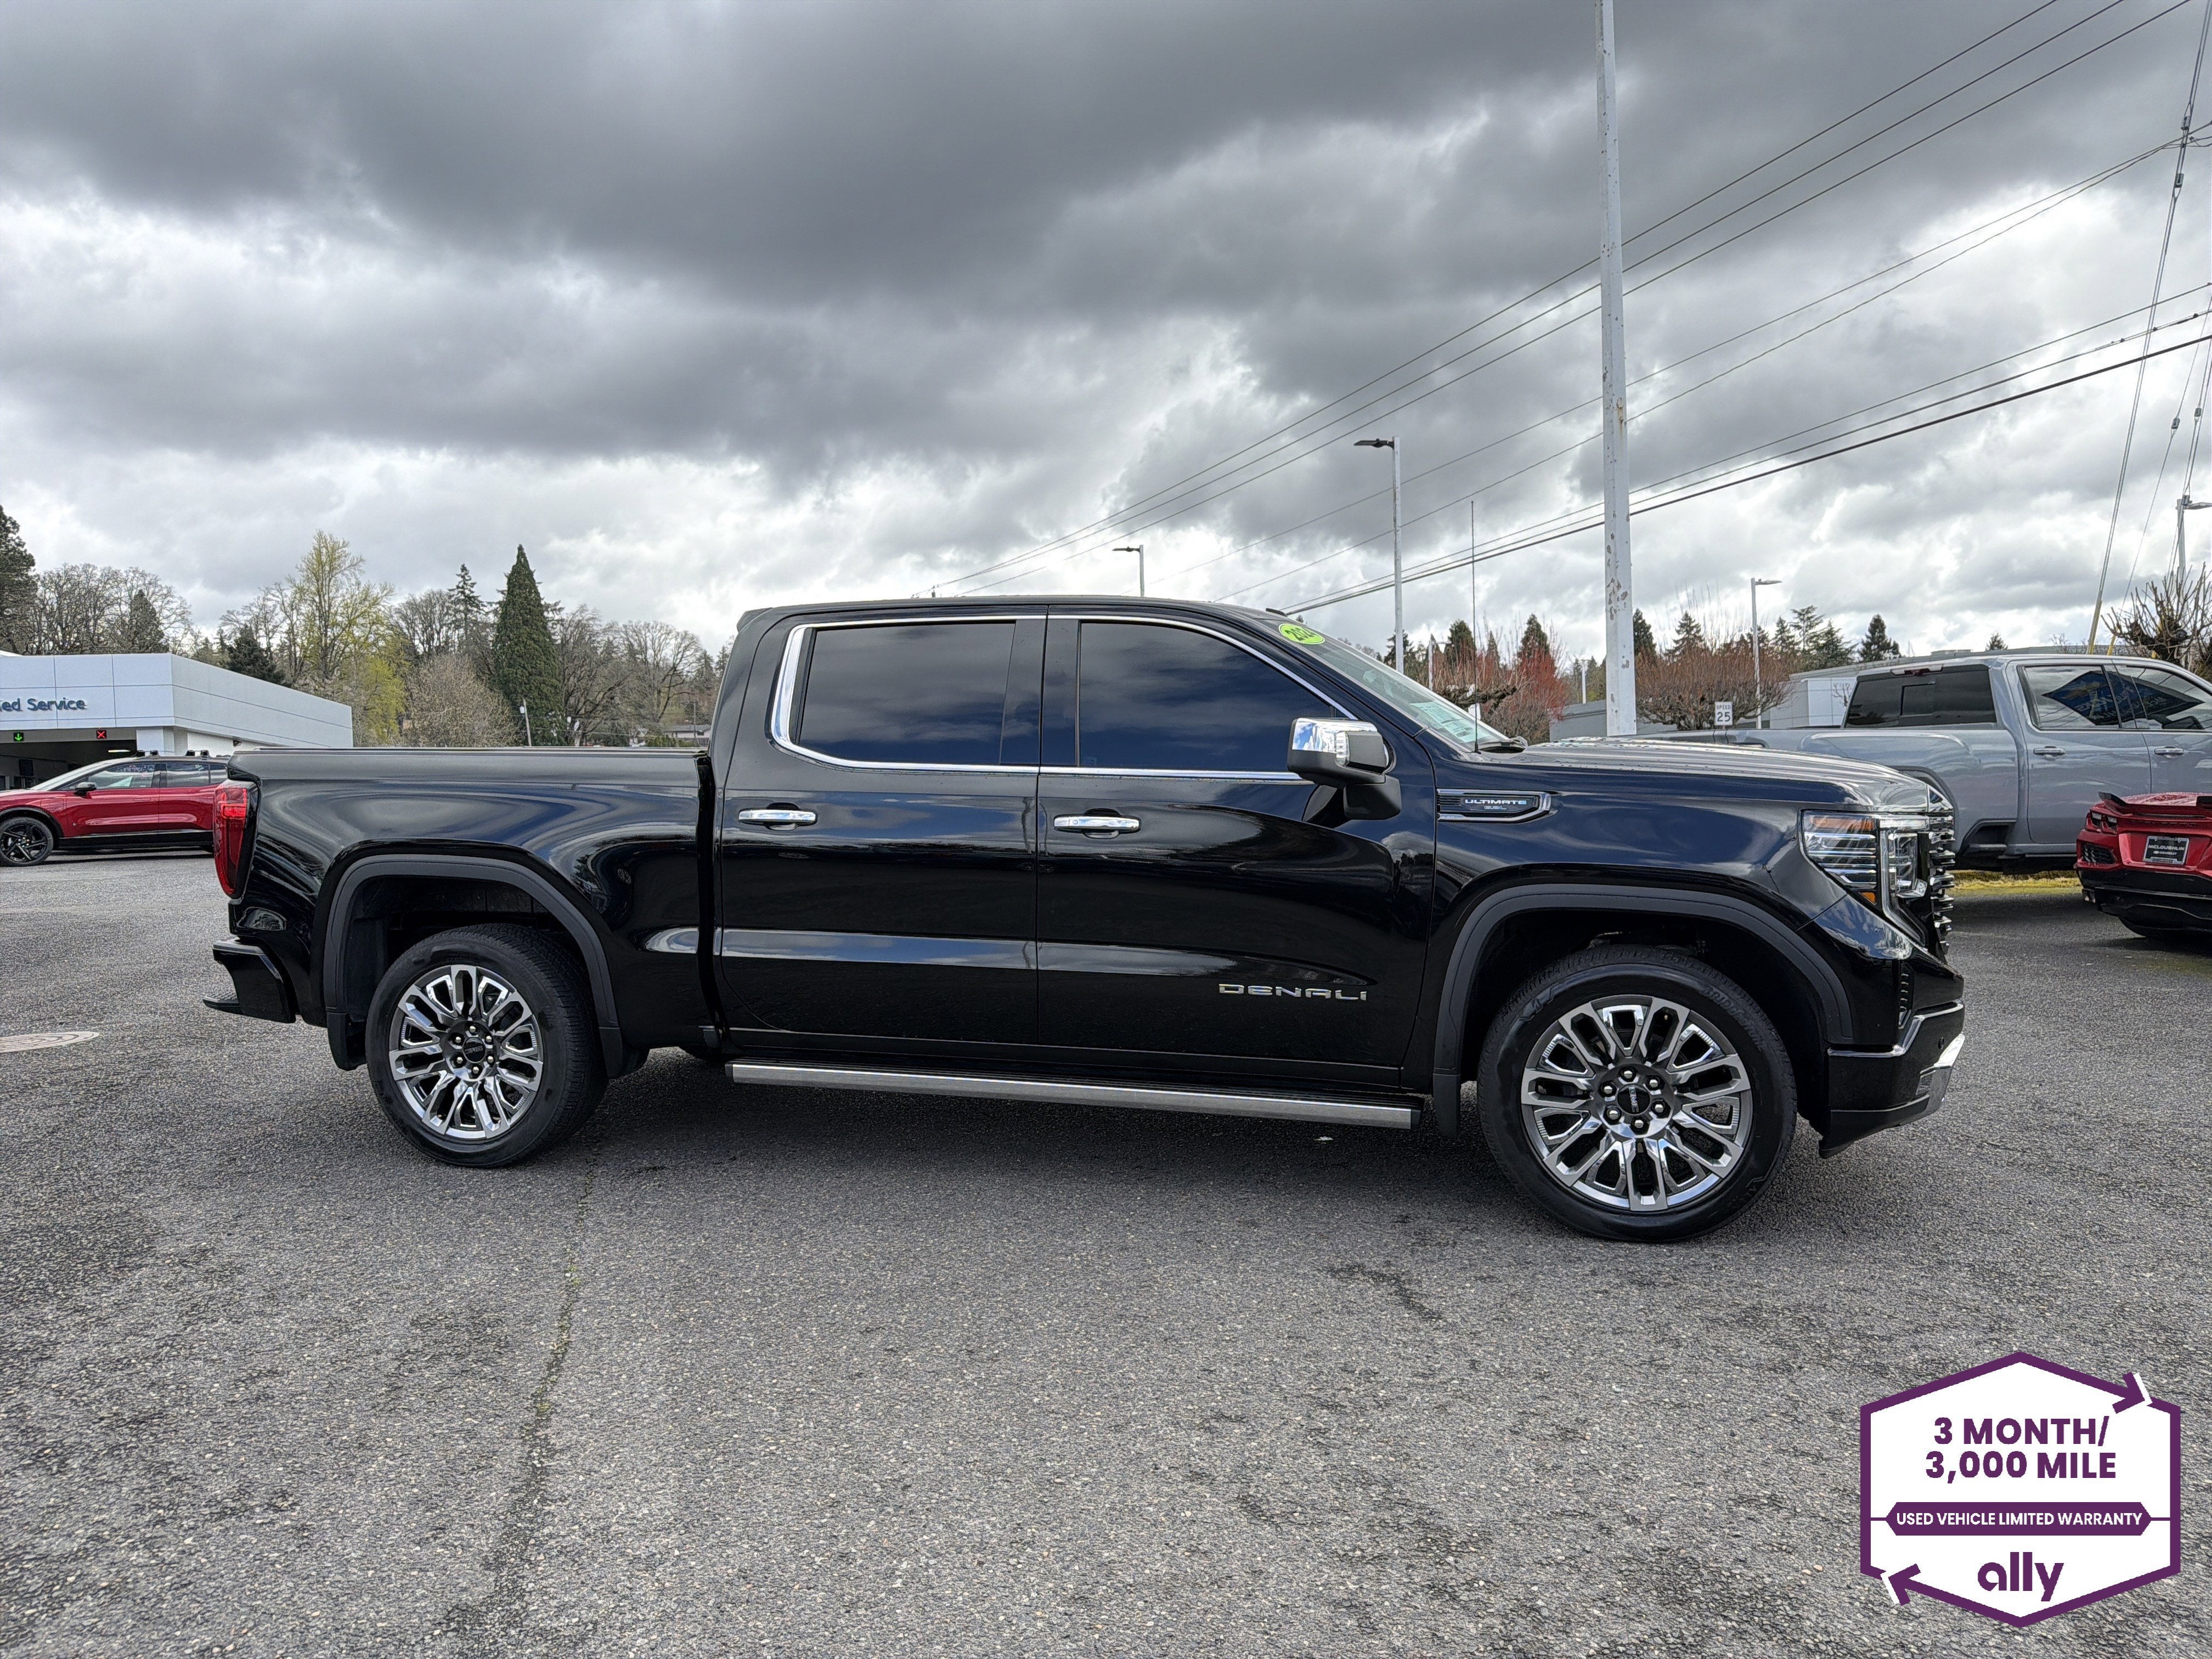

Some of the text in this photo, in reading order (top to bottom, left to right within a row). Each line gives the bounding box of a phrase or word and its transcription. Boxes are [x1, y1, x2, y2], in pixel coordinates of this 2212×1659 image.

[0, 697, 87, 712] ed Service
[1717, 712, 1731, 722] 25
[1218, 983, 1368, 1001] DENALI
[1628, 1086, 1639, 1113] GMC
